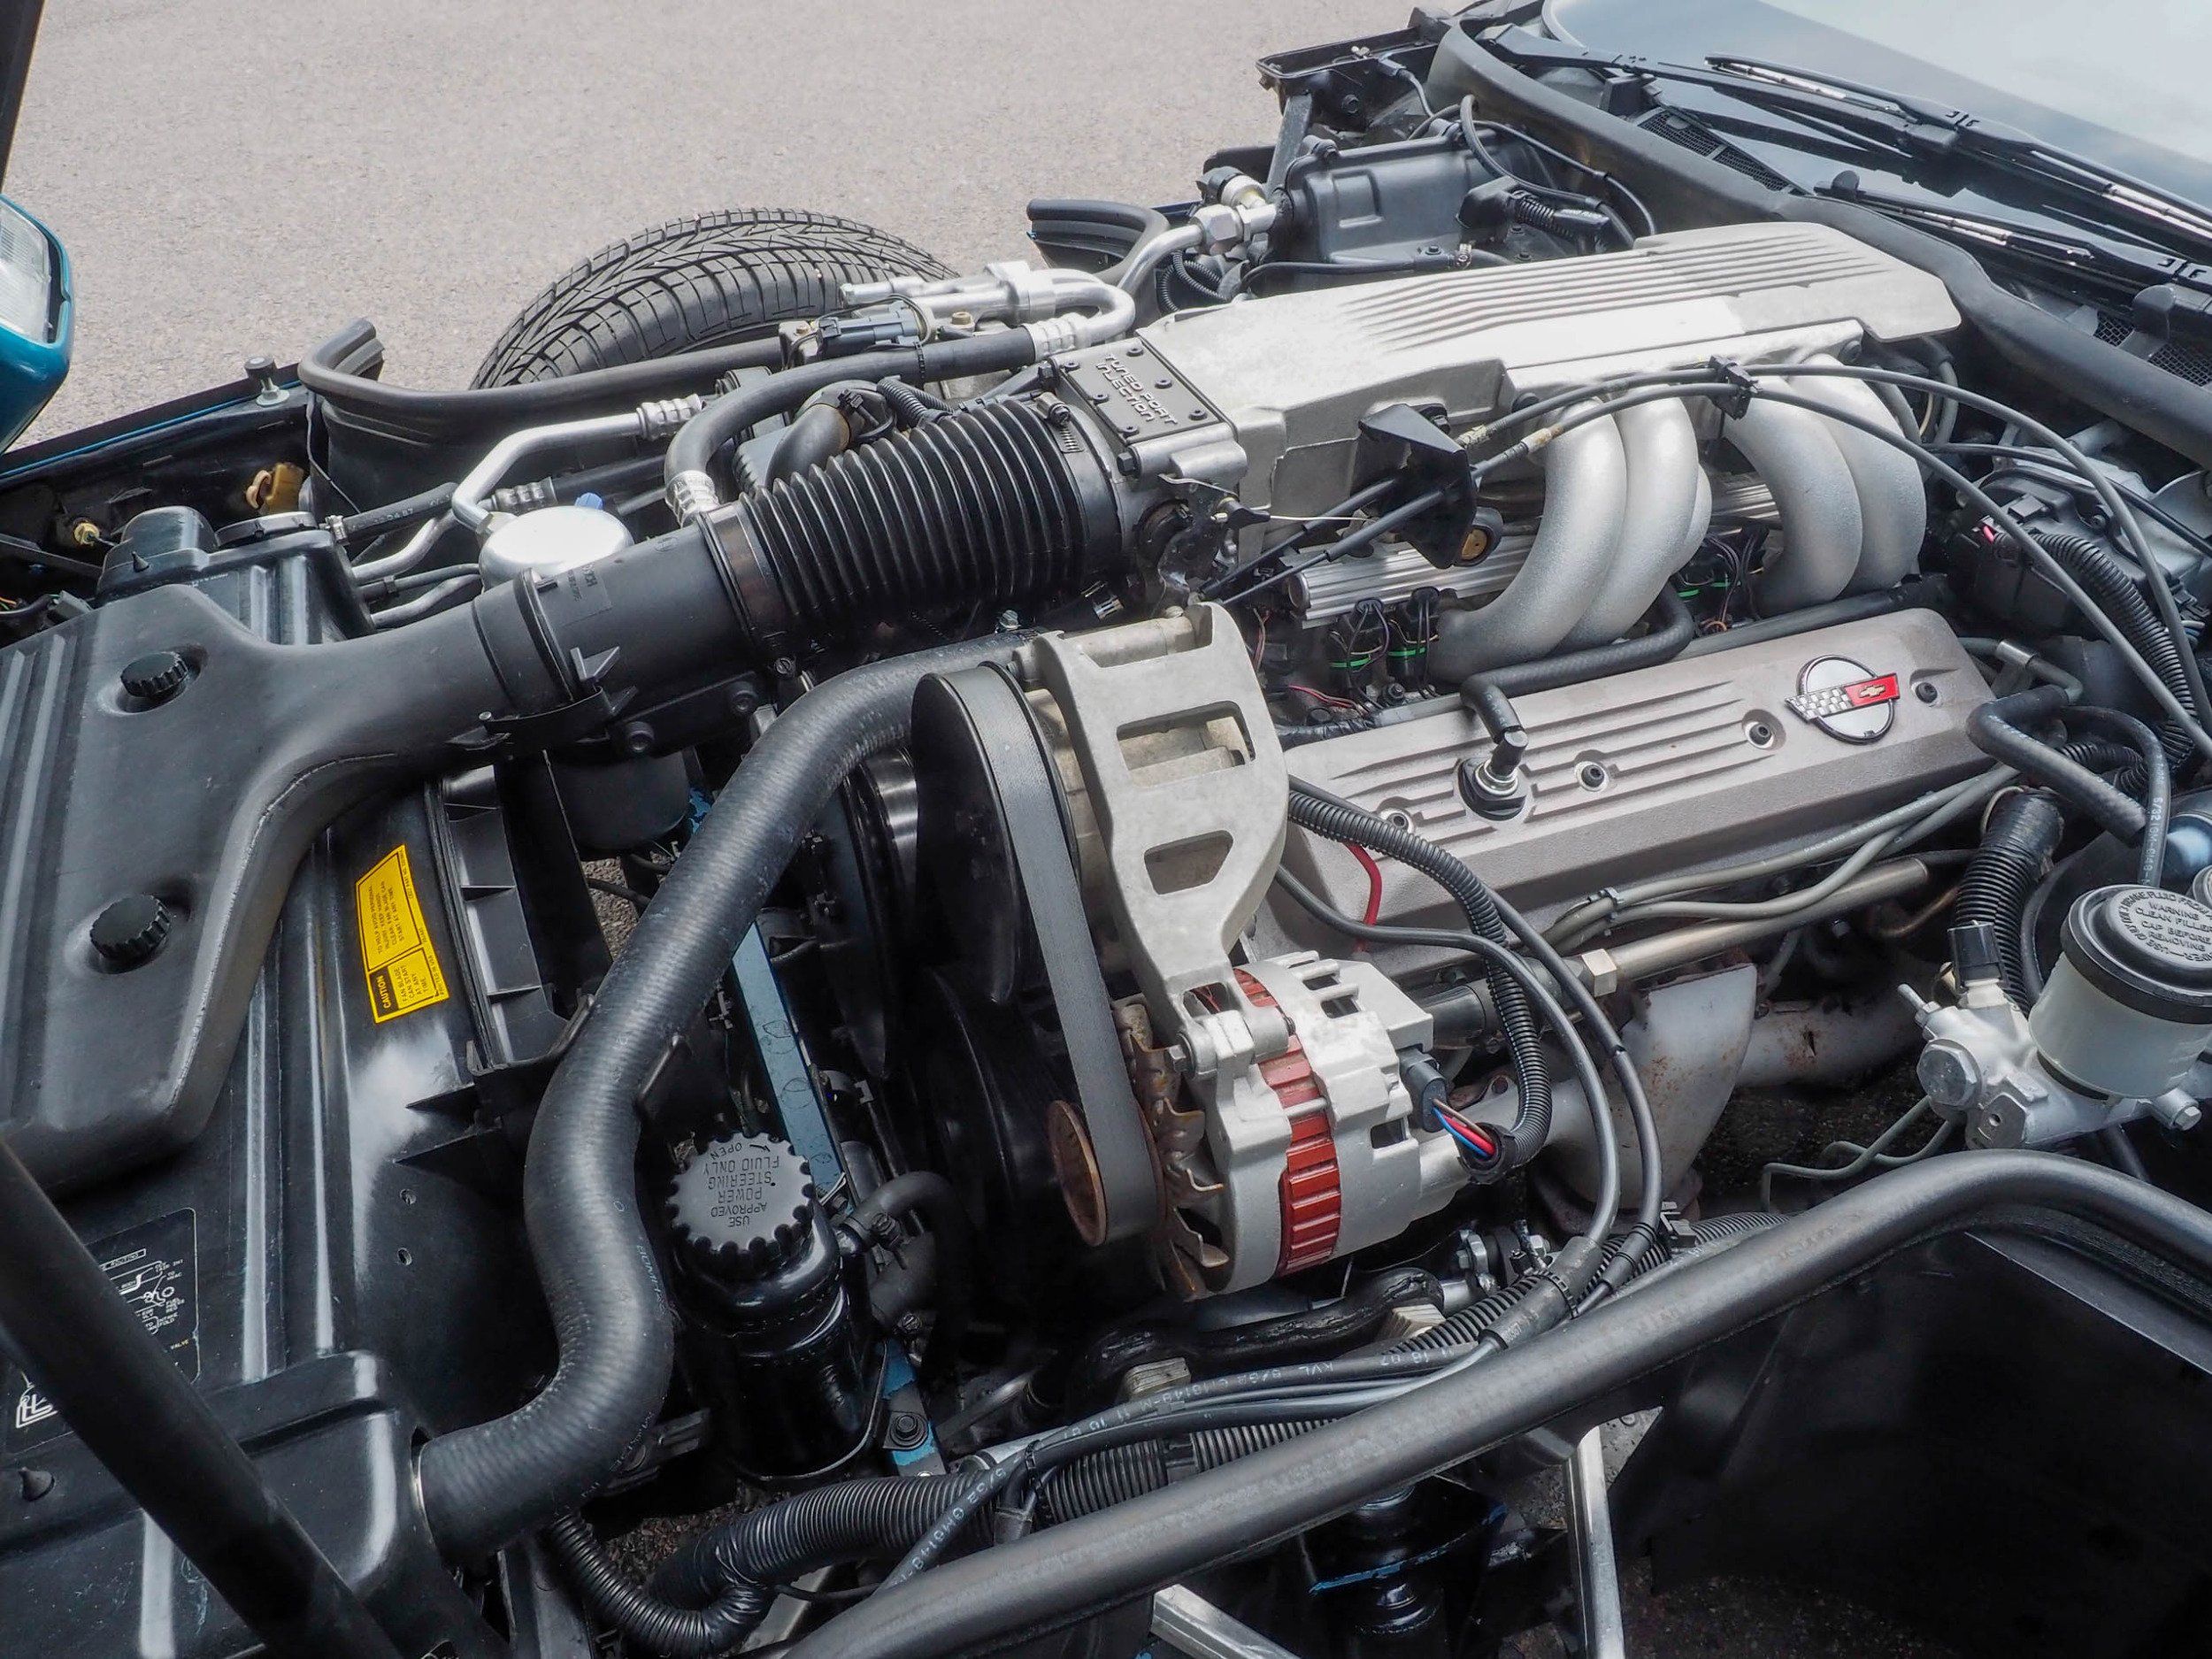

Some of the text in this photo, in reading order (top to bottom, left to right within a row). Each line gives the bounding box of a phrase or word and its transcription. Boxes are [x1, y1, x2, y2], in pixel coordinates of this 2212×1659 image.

[1096, 362, 1155, 422] INJECTION
[1105, 354, 1178, 425] TUNED PORT
[2135, 907, 2171, 923] CLEAN
[2148, 902, 2199, 921] WARNING
[2141, 920, 2212, 945] CAP BEFORE
[2148, 932, 2206, 952] REMOVING
[375, 974, 392, 1009] CAUTION
[710, 1142, 742, 1160] OPEN
[703, 1156, 780, 1176] FLUID ONLY
[708, 1171, 772, 1190] STEERING
[718, 1187, 762, 1204] POWER
[710, 1202, 767, 1217] APPROVED
[727, 1216, 750, 1228] USE
[1298, 1362, 1333, 1376] KVL
